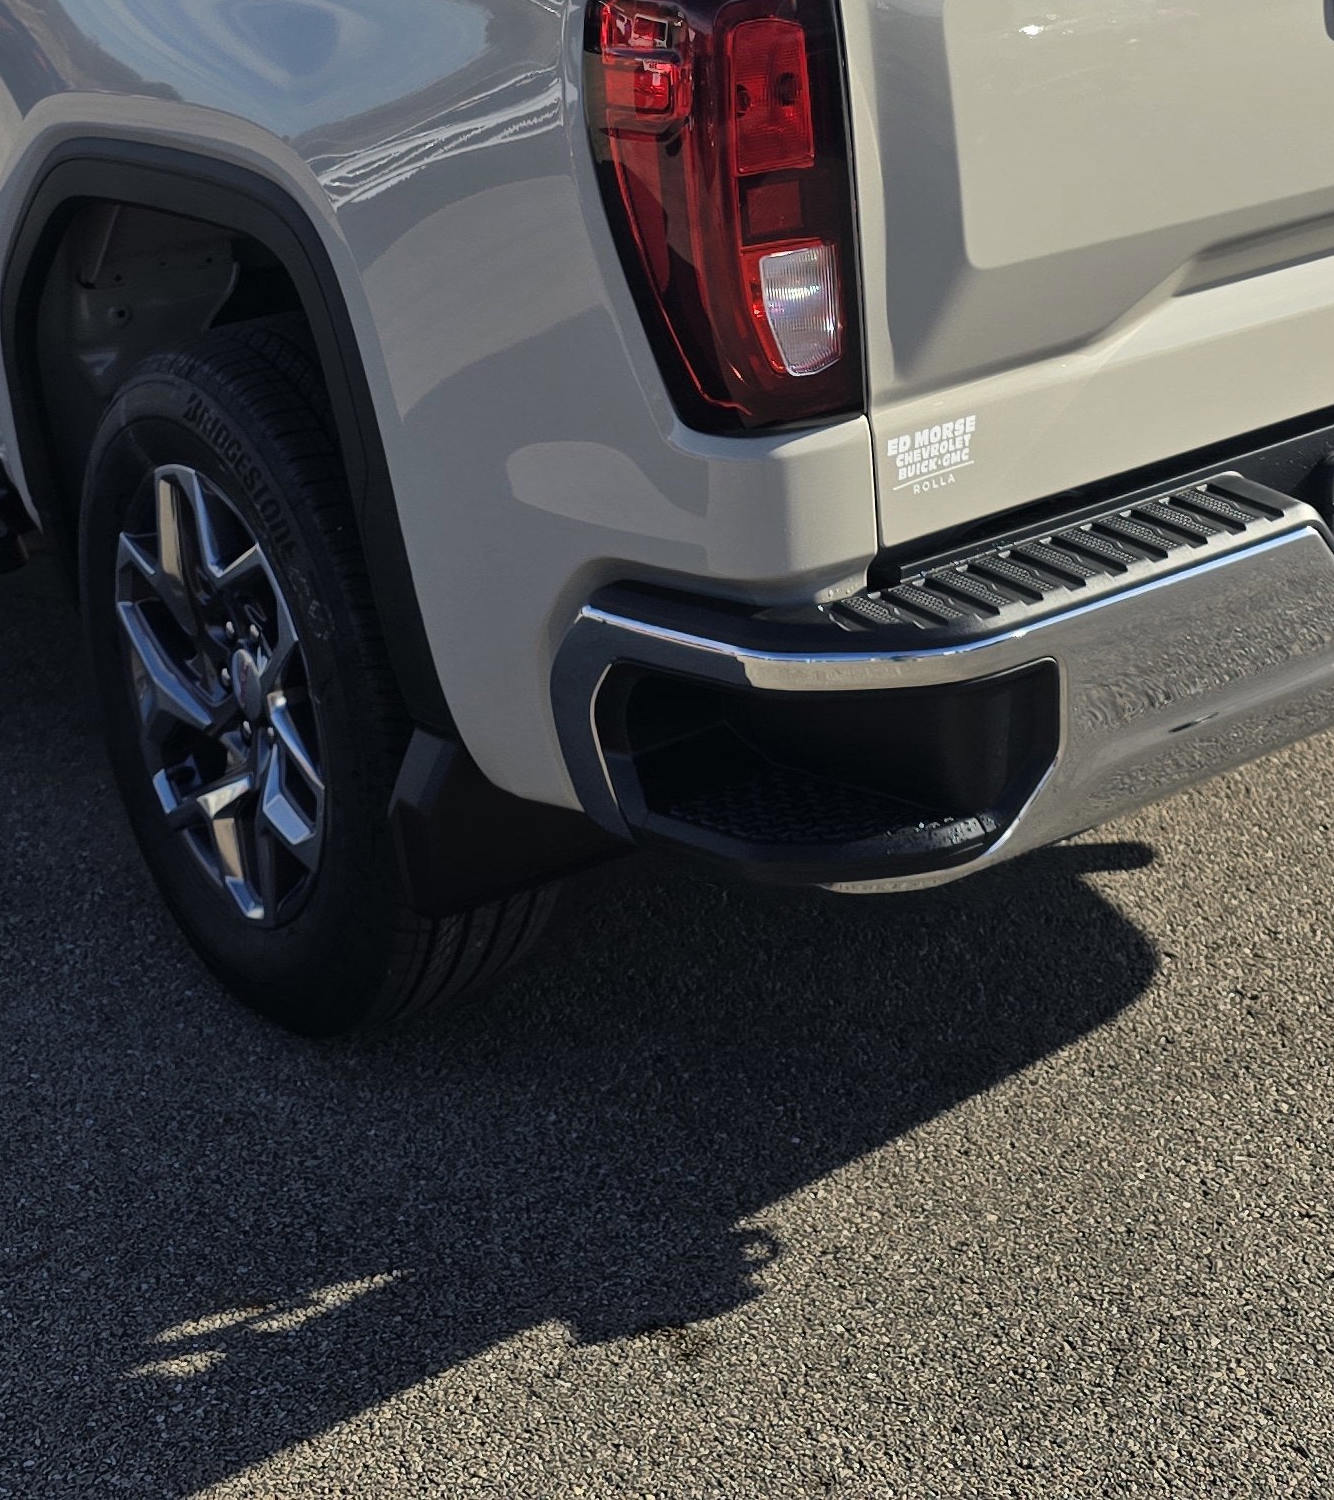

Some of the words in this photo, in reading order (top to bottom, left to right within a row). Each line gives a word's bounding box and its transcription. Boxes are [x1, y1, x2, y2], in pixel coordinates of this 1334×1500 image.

[886, 434, 912, 457] ED
[914, 414, 976, 449] MORSE
[895, 433, 972, 468] CHEVROLET
[182, 392, 297, 563] BRIDGESTONE
[912, 473, 956, 495] ROLLA
